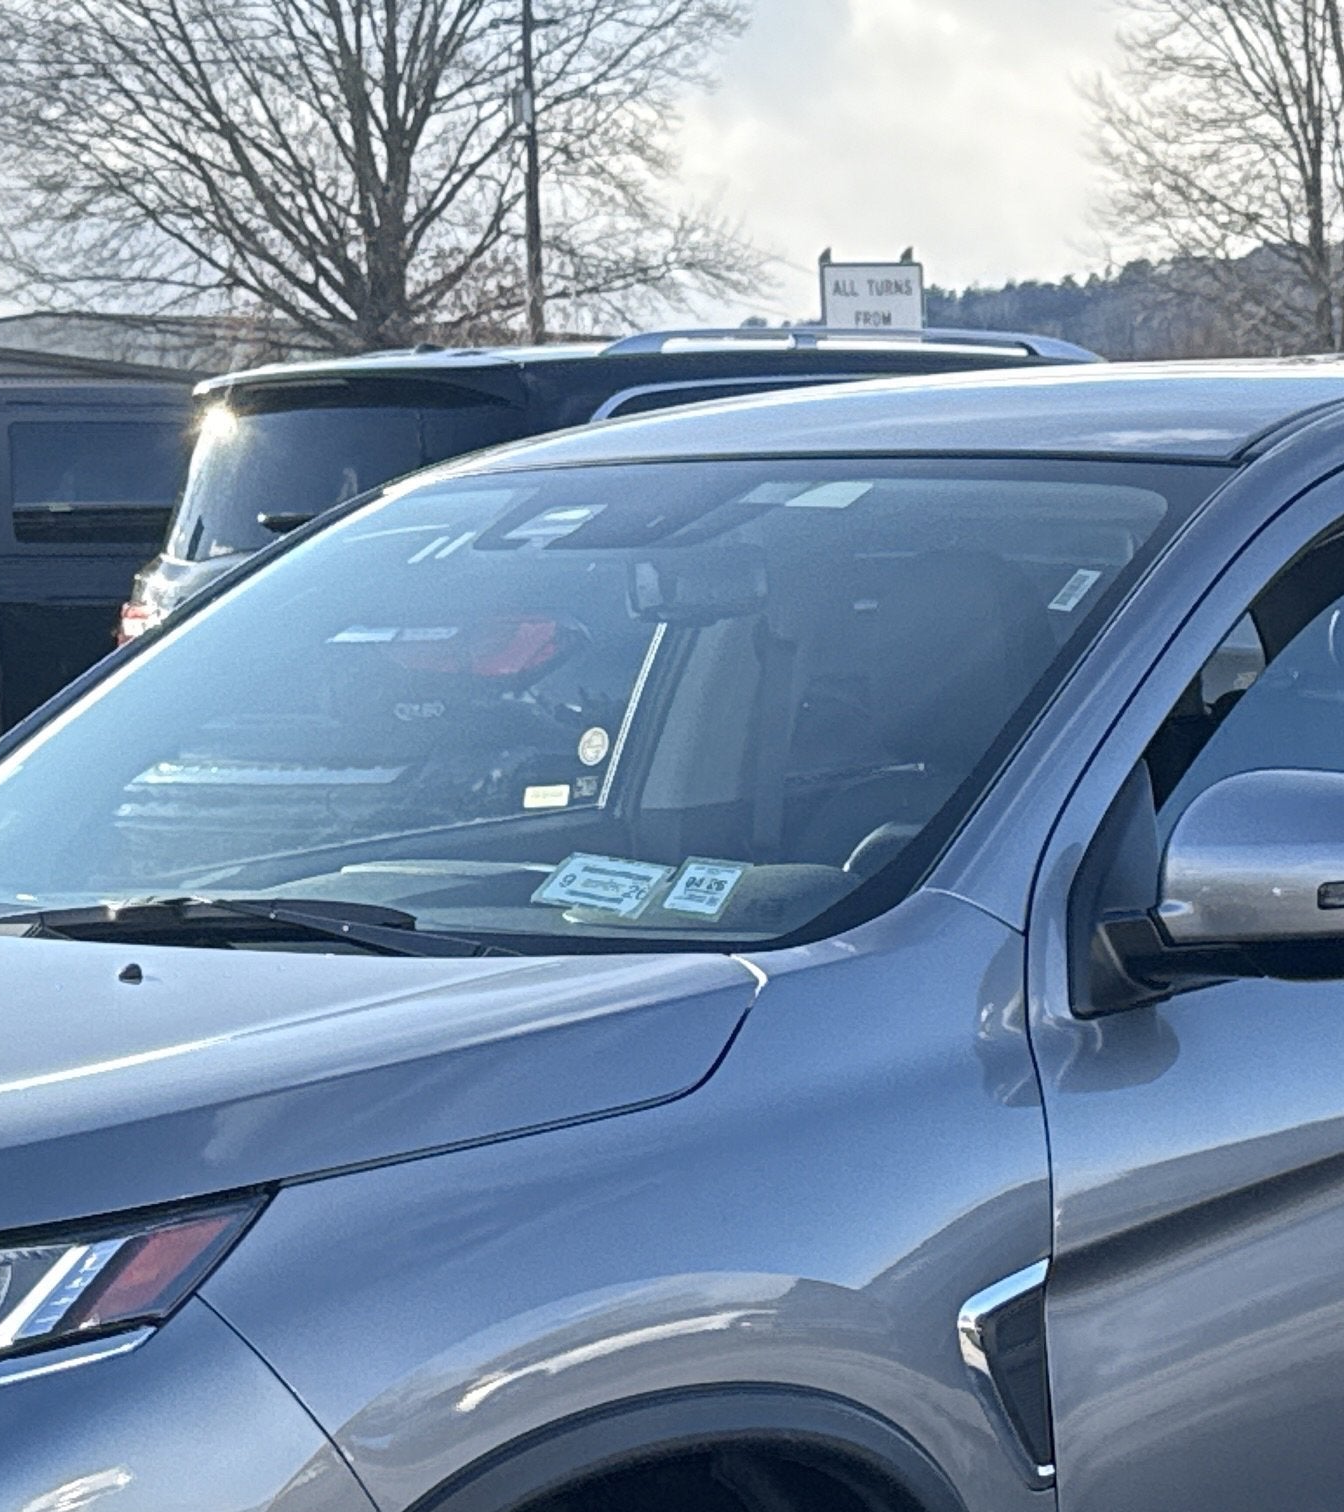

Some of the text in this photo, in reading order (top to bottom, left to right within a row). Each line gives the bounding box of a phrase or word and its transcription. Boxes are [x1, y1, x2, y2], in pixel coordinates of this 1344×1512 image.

[832, 279, 913, 297] ALL TURNS
[854, 310, 892, 326] FROM
